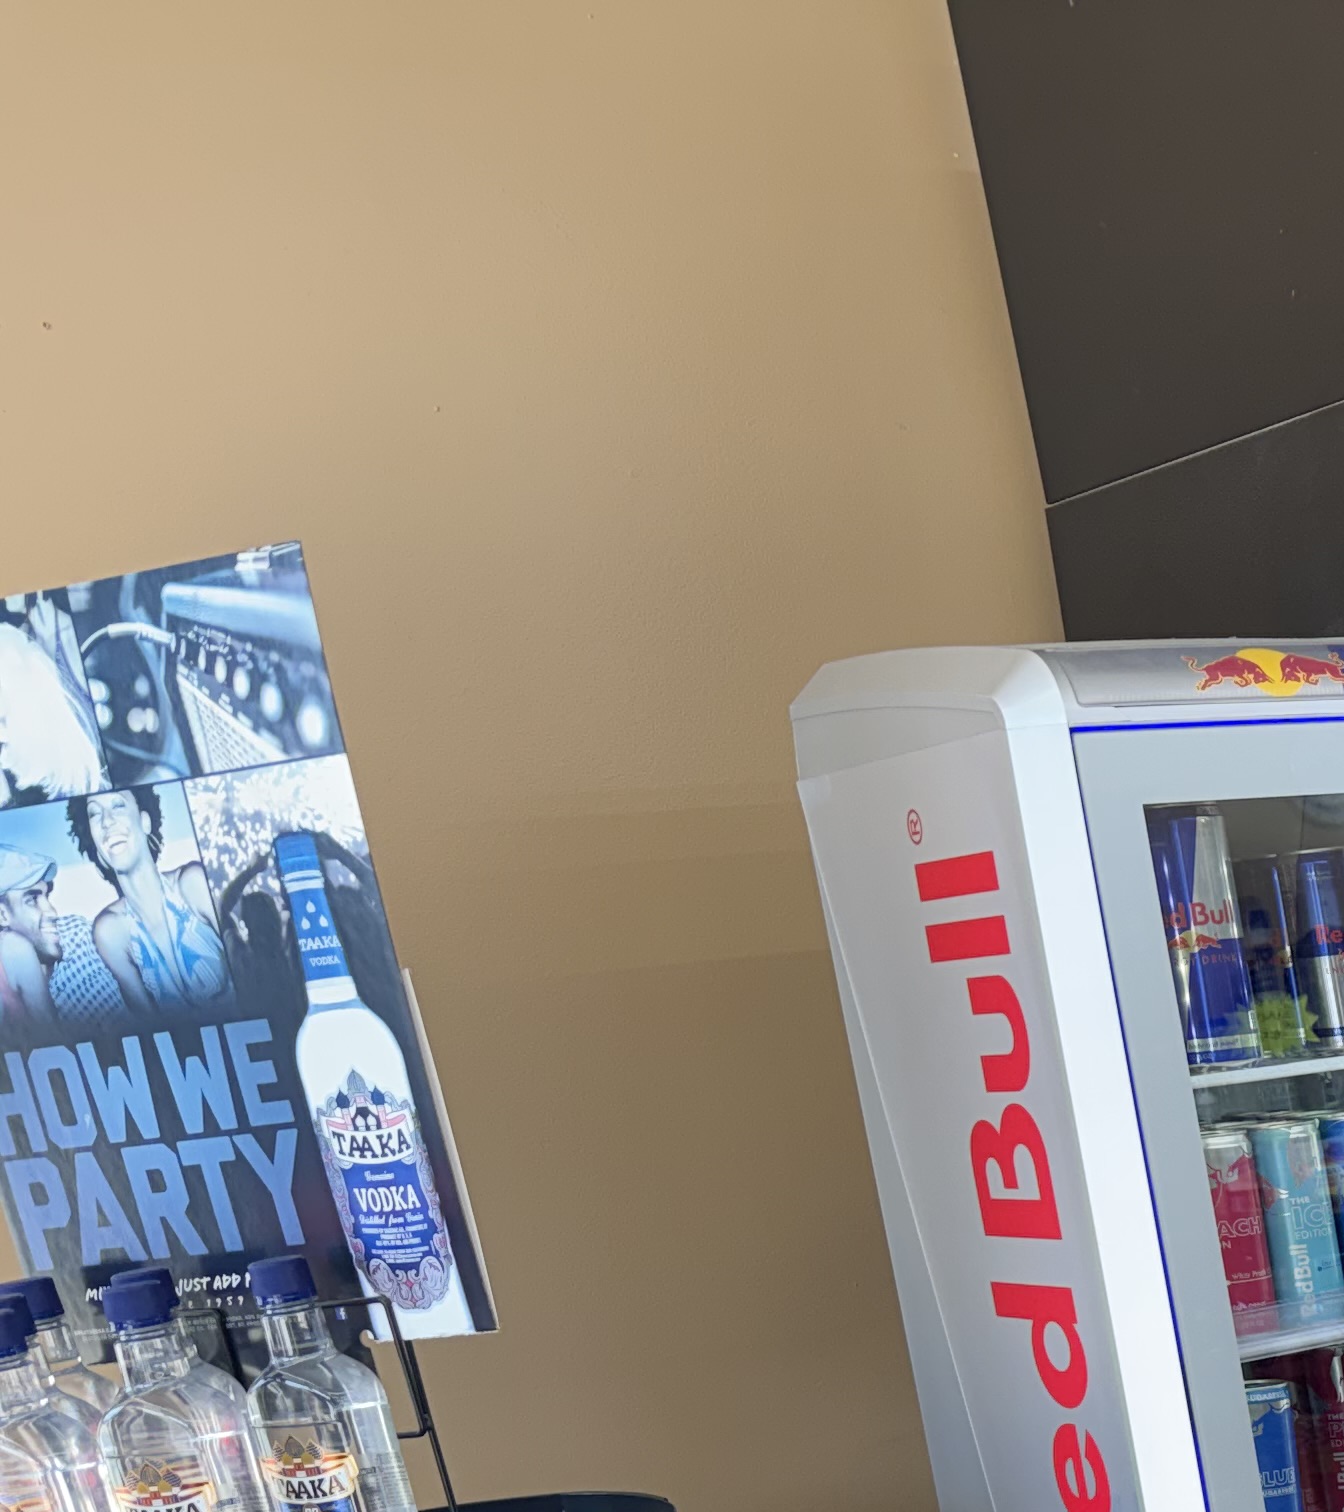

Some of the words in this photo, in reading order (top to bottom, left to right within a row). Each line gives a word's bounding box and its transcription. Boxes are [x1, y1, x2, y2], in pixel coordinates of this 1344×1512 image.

[1190, 899, 1234, 926] Bull
[299, 934, 343, 952] TAAKA
[309, 956, 341, 967] VODKA
[914, 849, 1064, 1242] Bull
[0, 1035, 161, 1158] HOW
[153, 1018, 296, 1135] WE
[331, 1129, 412, 1159] TAAKA
[4, 1128, 306, 1272] PARTY
[353, 1183, 422, 1213] VODKA
[1217, 1215, 1262, 1239] ACH
[1290, 1243, 1313, 1281] Bull
[174, 1274, 211, 1297] JUST
[212, 1271, 243, 1293] ADD
